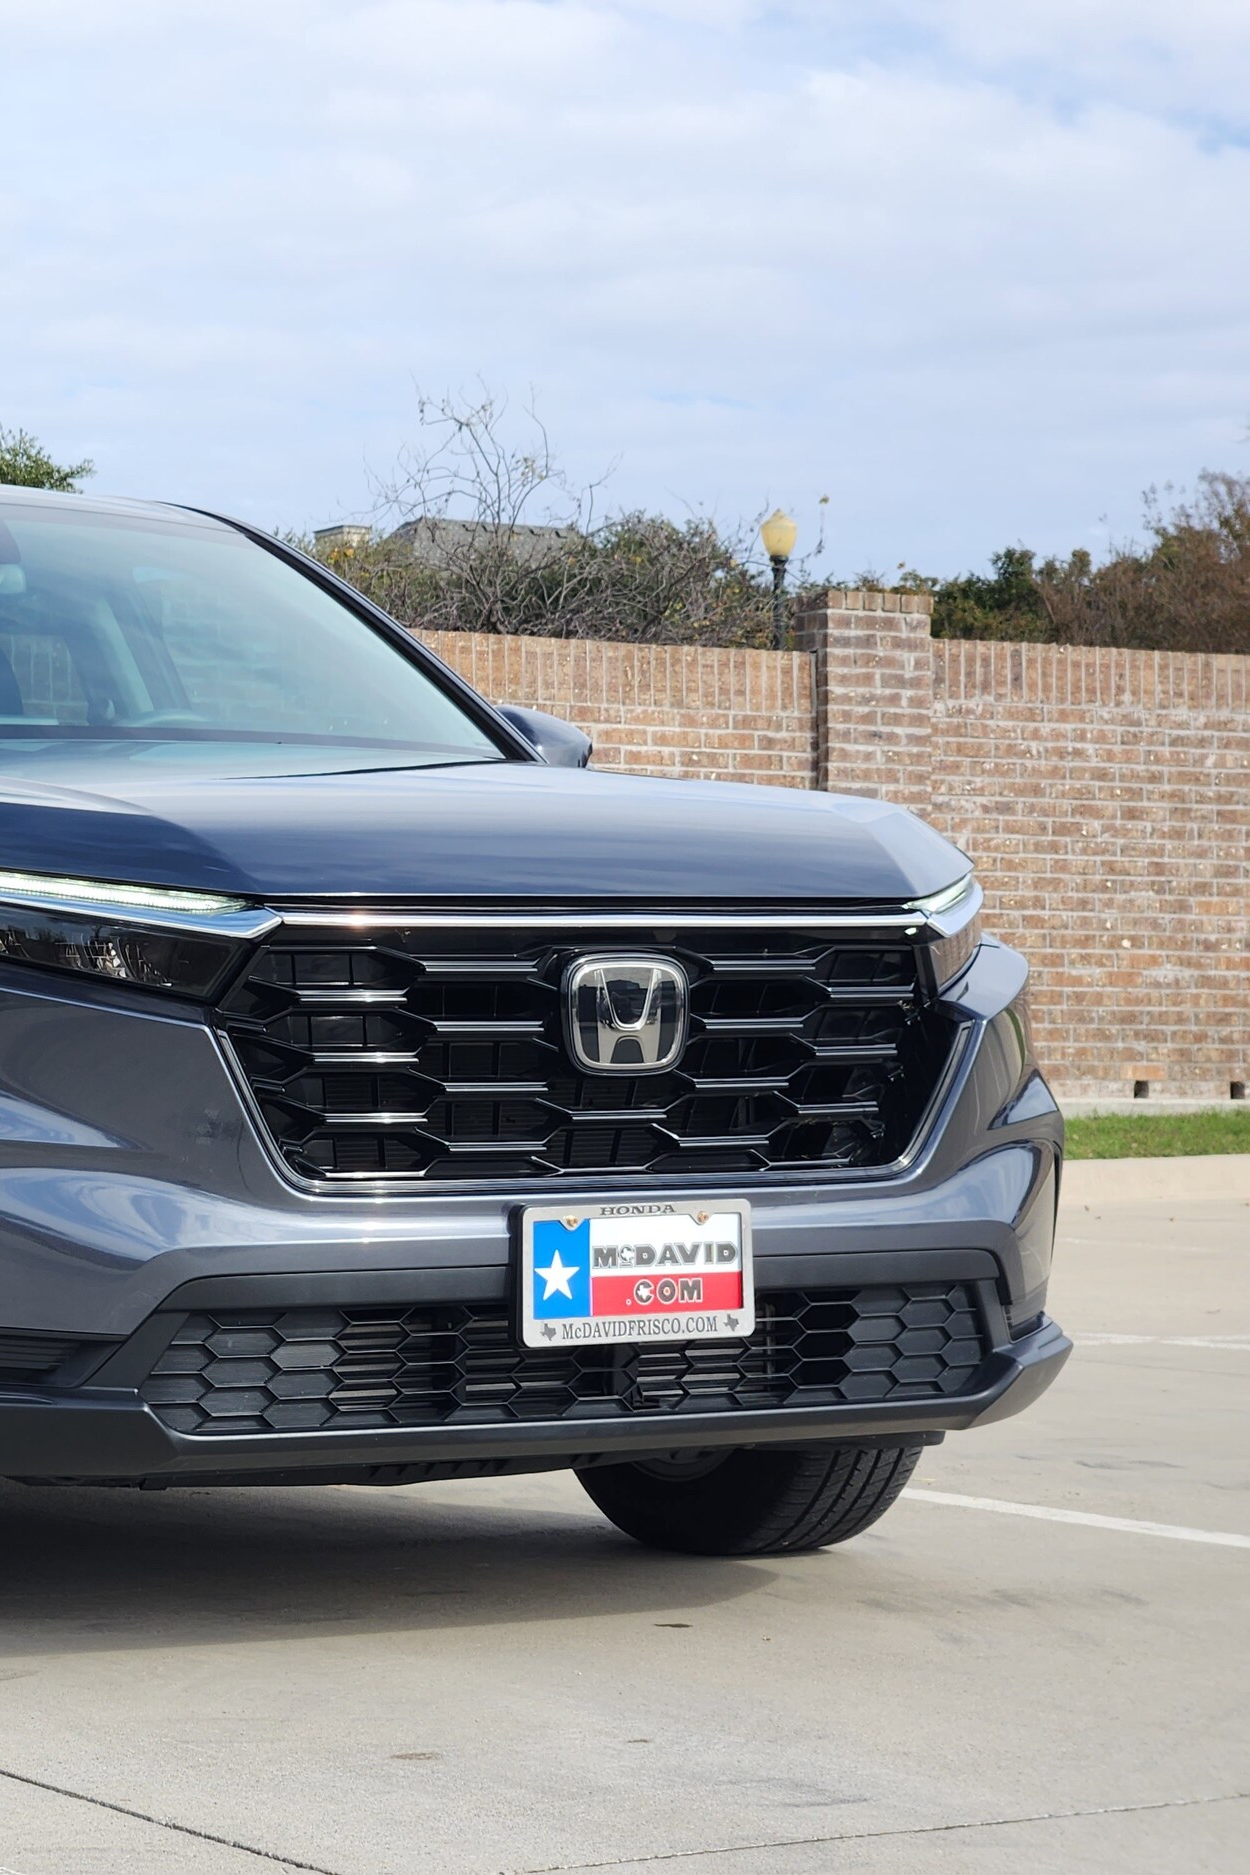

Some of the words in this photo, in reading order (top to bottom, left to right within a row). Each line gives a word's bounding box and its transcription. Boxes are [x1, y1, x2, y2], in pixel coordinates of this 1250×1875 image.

[600, 1204, 676, 1216] HONDA
[626, 1278, 703, 1306] .COM
[562, 1316, 718, 1340] McDAVIDFRISCO.COM
